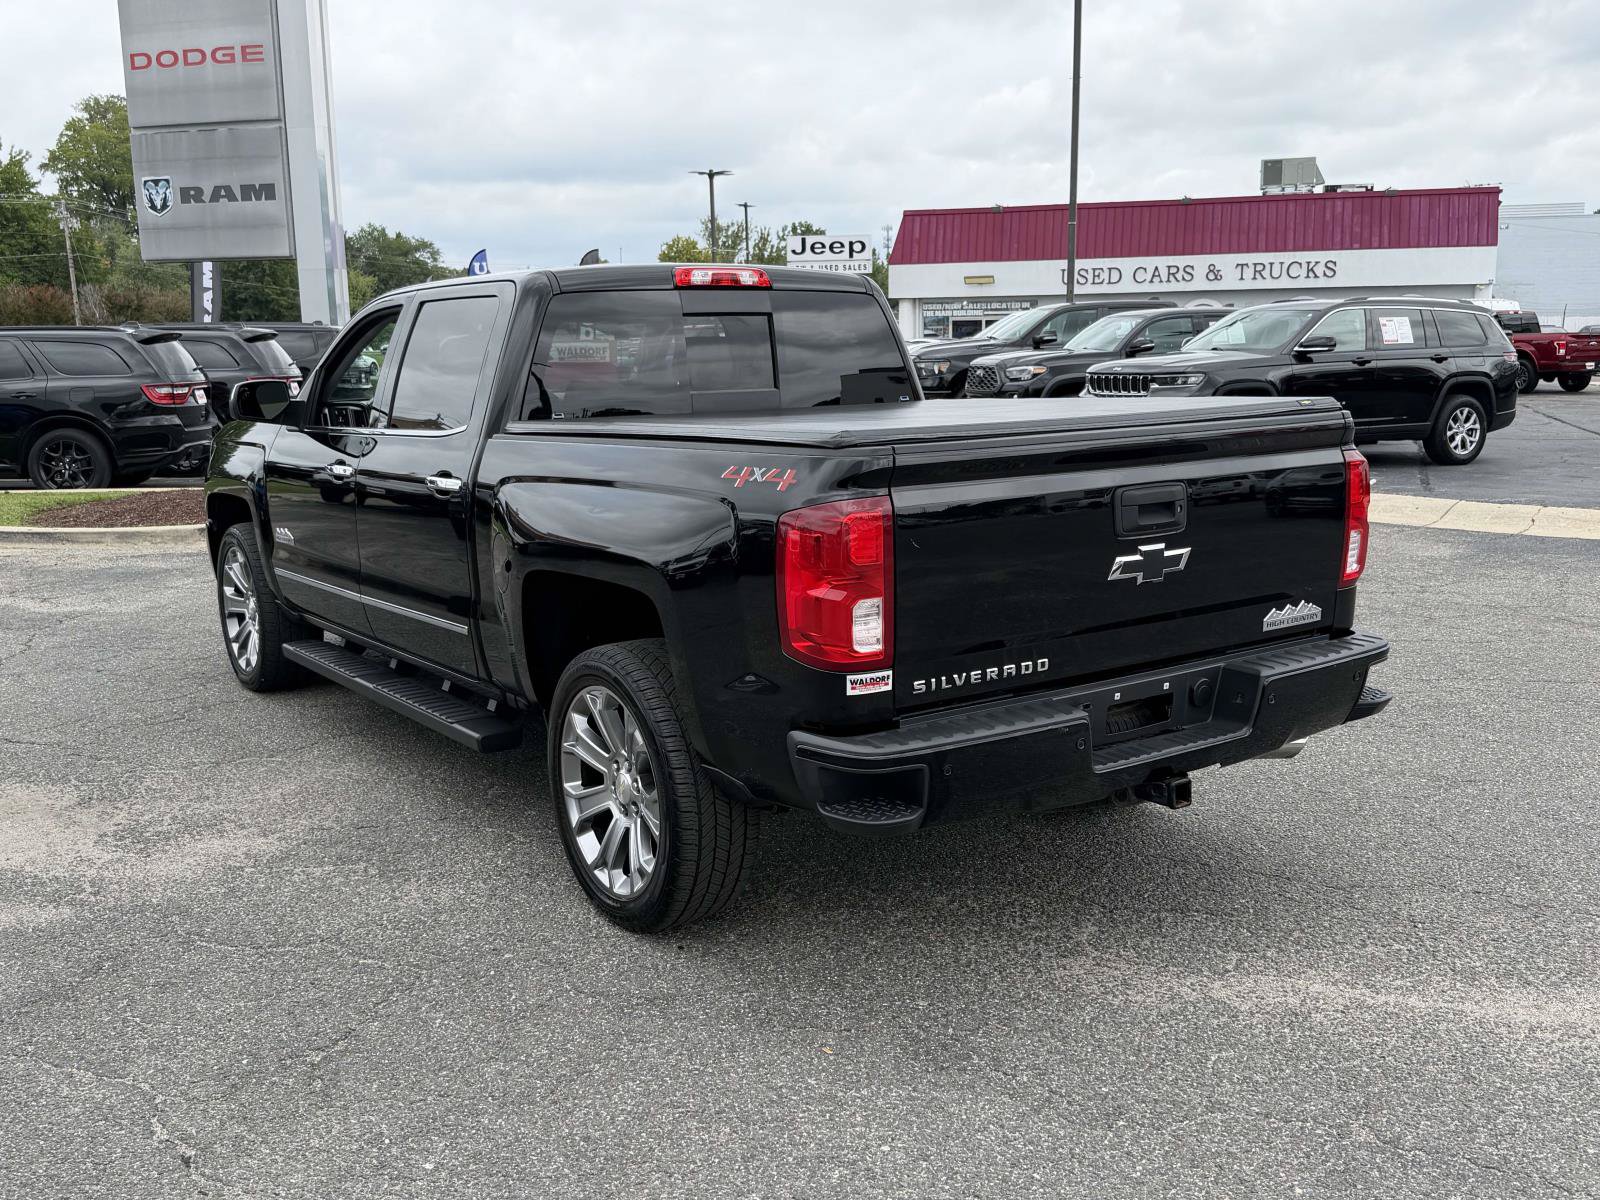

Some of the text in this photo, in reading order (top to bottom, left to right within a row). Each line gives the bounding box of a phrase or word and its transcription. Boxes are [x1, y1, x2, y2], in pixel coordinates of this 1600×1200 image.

[129, 44, 265, 71] DODGE
[179, 182, 277, 205] RAM
[791, 237, 867, 259] Jeep
[842, 263, 868, 271] SALES
[1132, 264, 1195, 284] CARS
[1205, 263, 1223, 282] &
[1235, 260, 1337, 280] TRUCKS
[987, 301, 1021, 309] LOCATED
[557, 346, 608, 357] WALDORF
[1266, 612, 1319, 628] HIGH COUNTRY
[849, 674, 891, 686] WALDORF
[912, 658, 1049, 694] SILVERADO
